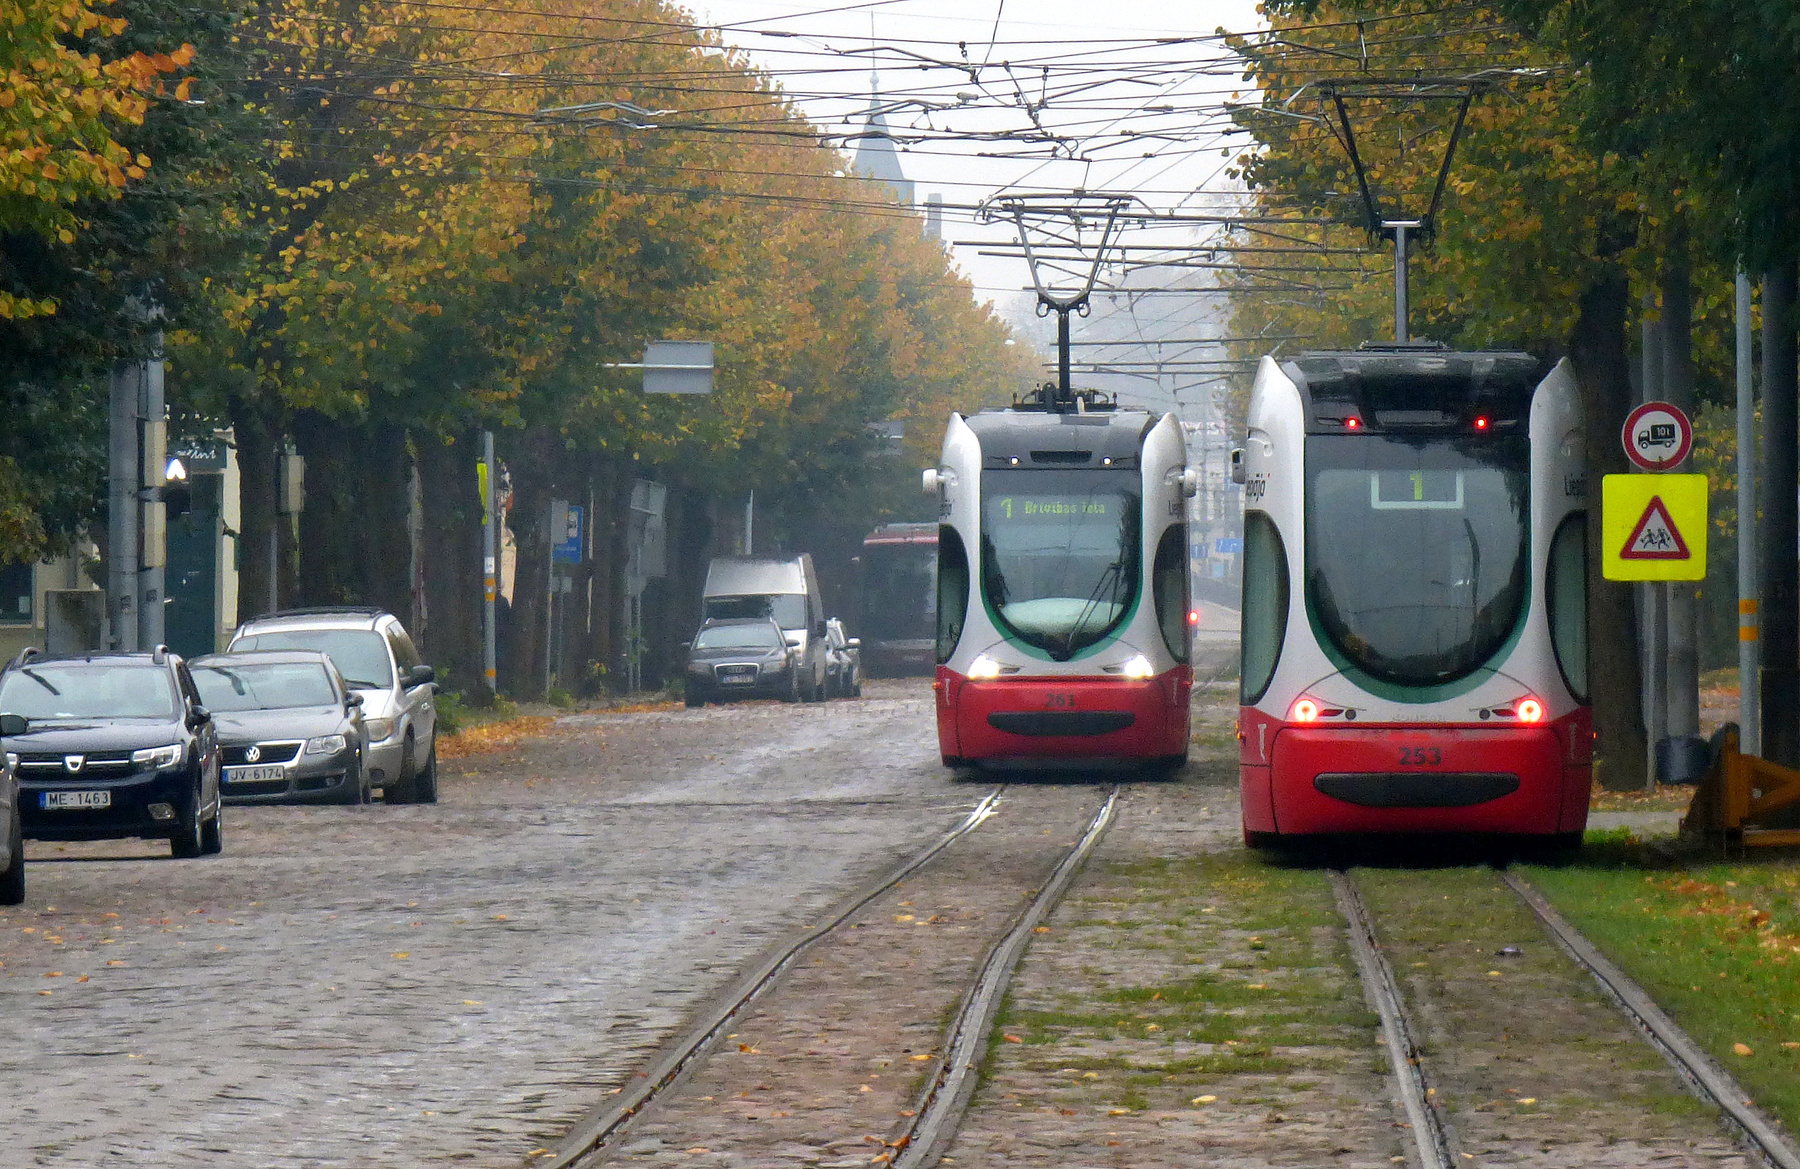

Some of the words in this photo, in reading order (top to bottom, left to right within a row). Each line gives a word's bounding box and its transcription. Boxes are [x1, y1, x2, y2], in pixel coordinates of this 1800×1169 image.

[1410, 472, 1423, 501] 1
[1000, 498, 1012, 519] 1
[1045, 692, 1075, 706] 261
[1398, 746, 1442, 766] 253
[231, 768, 282, 781] JV-6174
[48, 792, 109, 806] ME-1463
